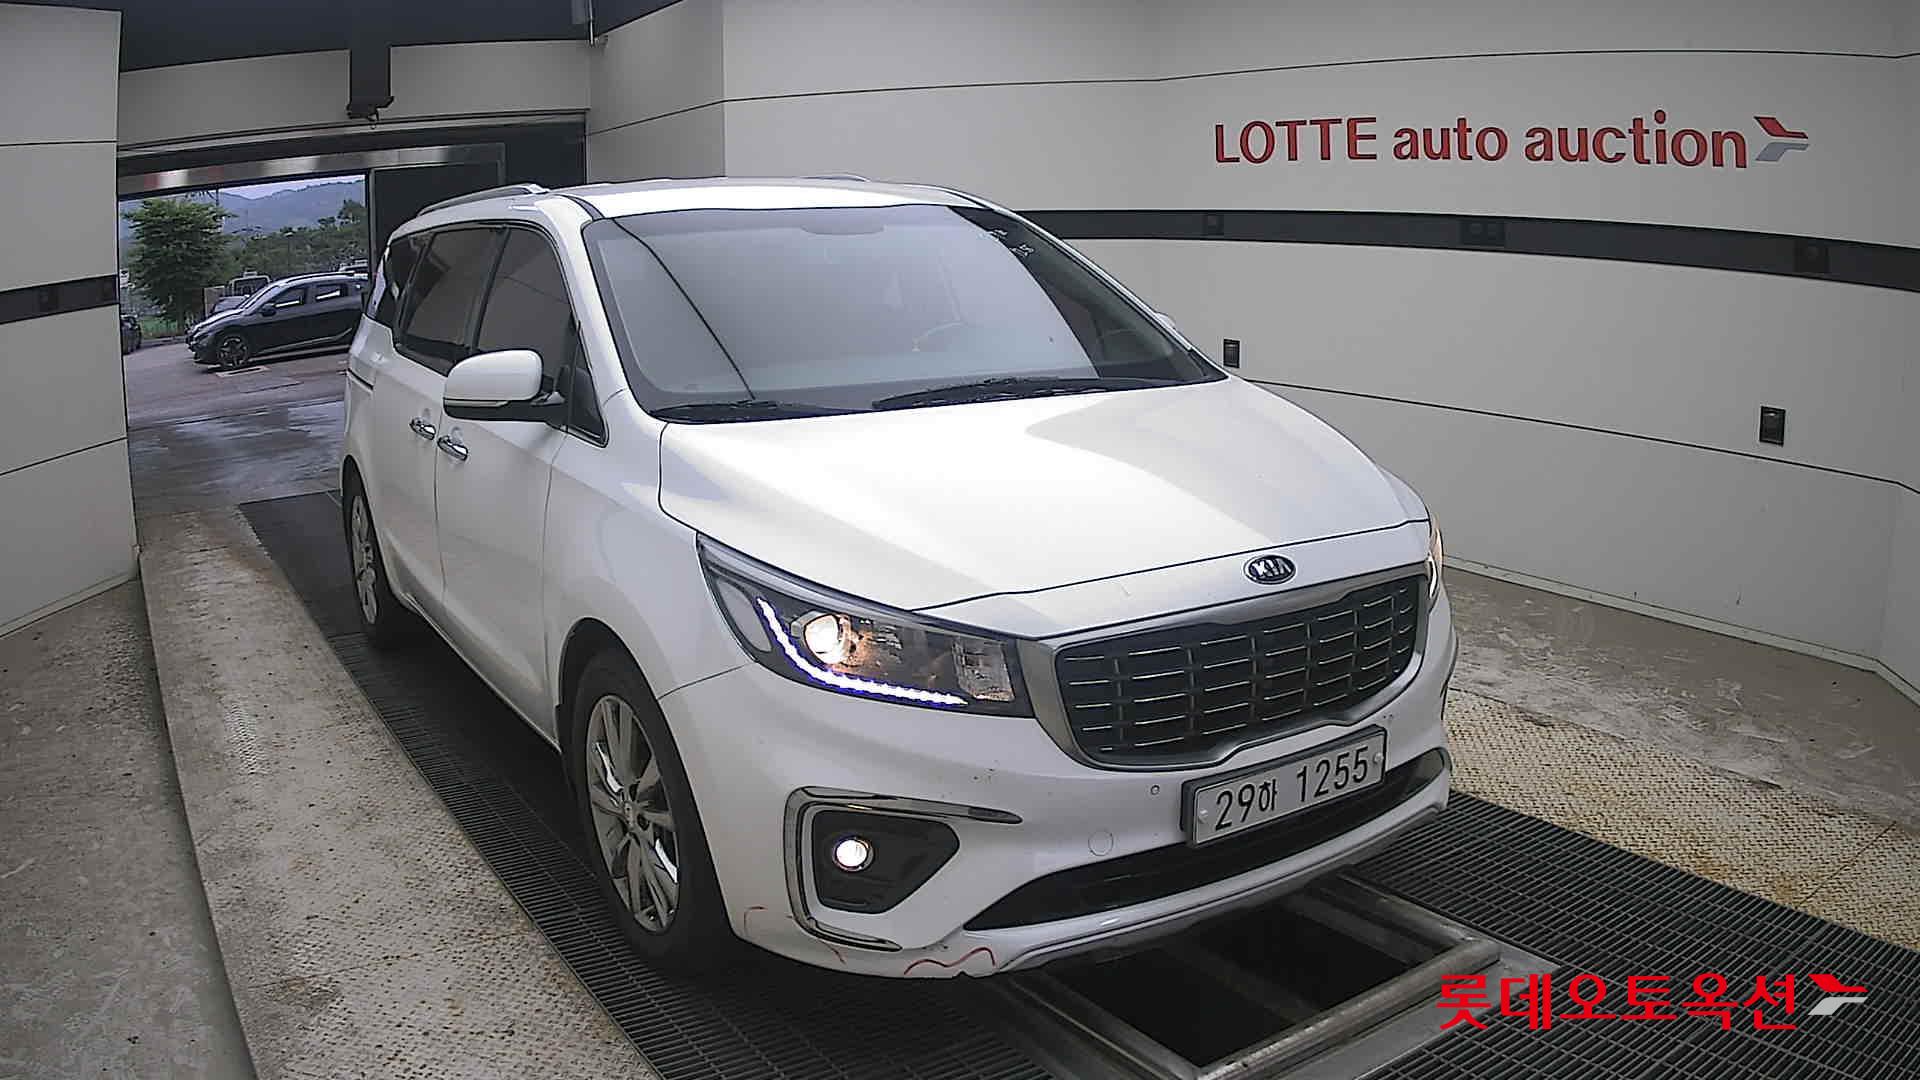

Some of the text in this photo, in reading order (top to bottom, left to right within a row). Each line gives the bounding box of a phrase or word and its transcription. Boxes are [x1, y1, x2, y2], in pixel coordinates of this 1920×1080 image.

[1215, 109, 1748, 169] LOTTE auto auction
[1251, 557, 1292, 577] KIA
[1215, 745, 1369, 831] 29하 1255
